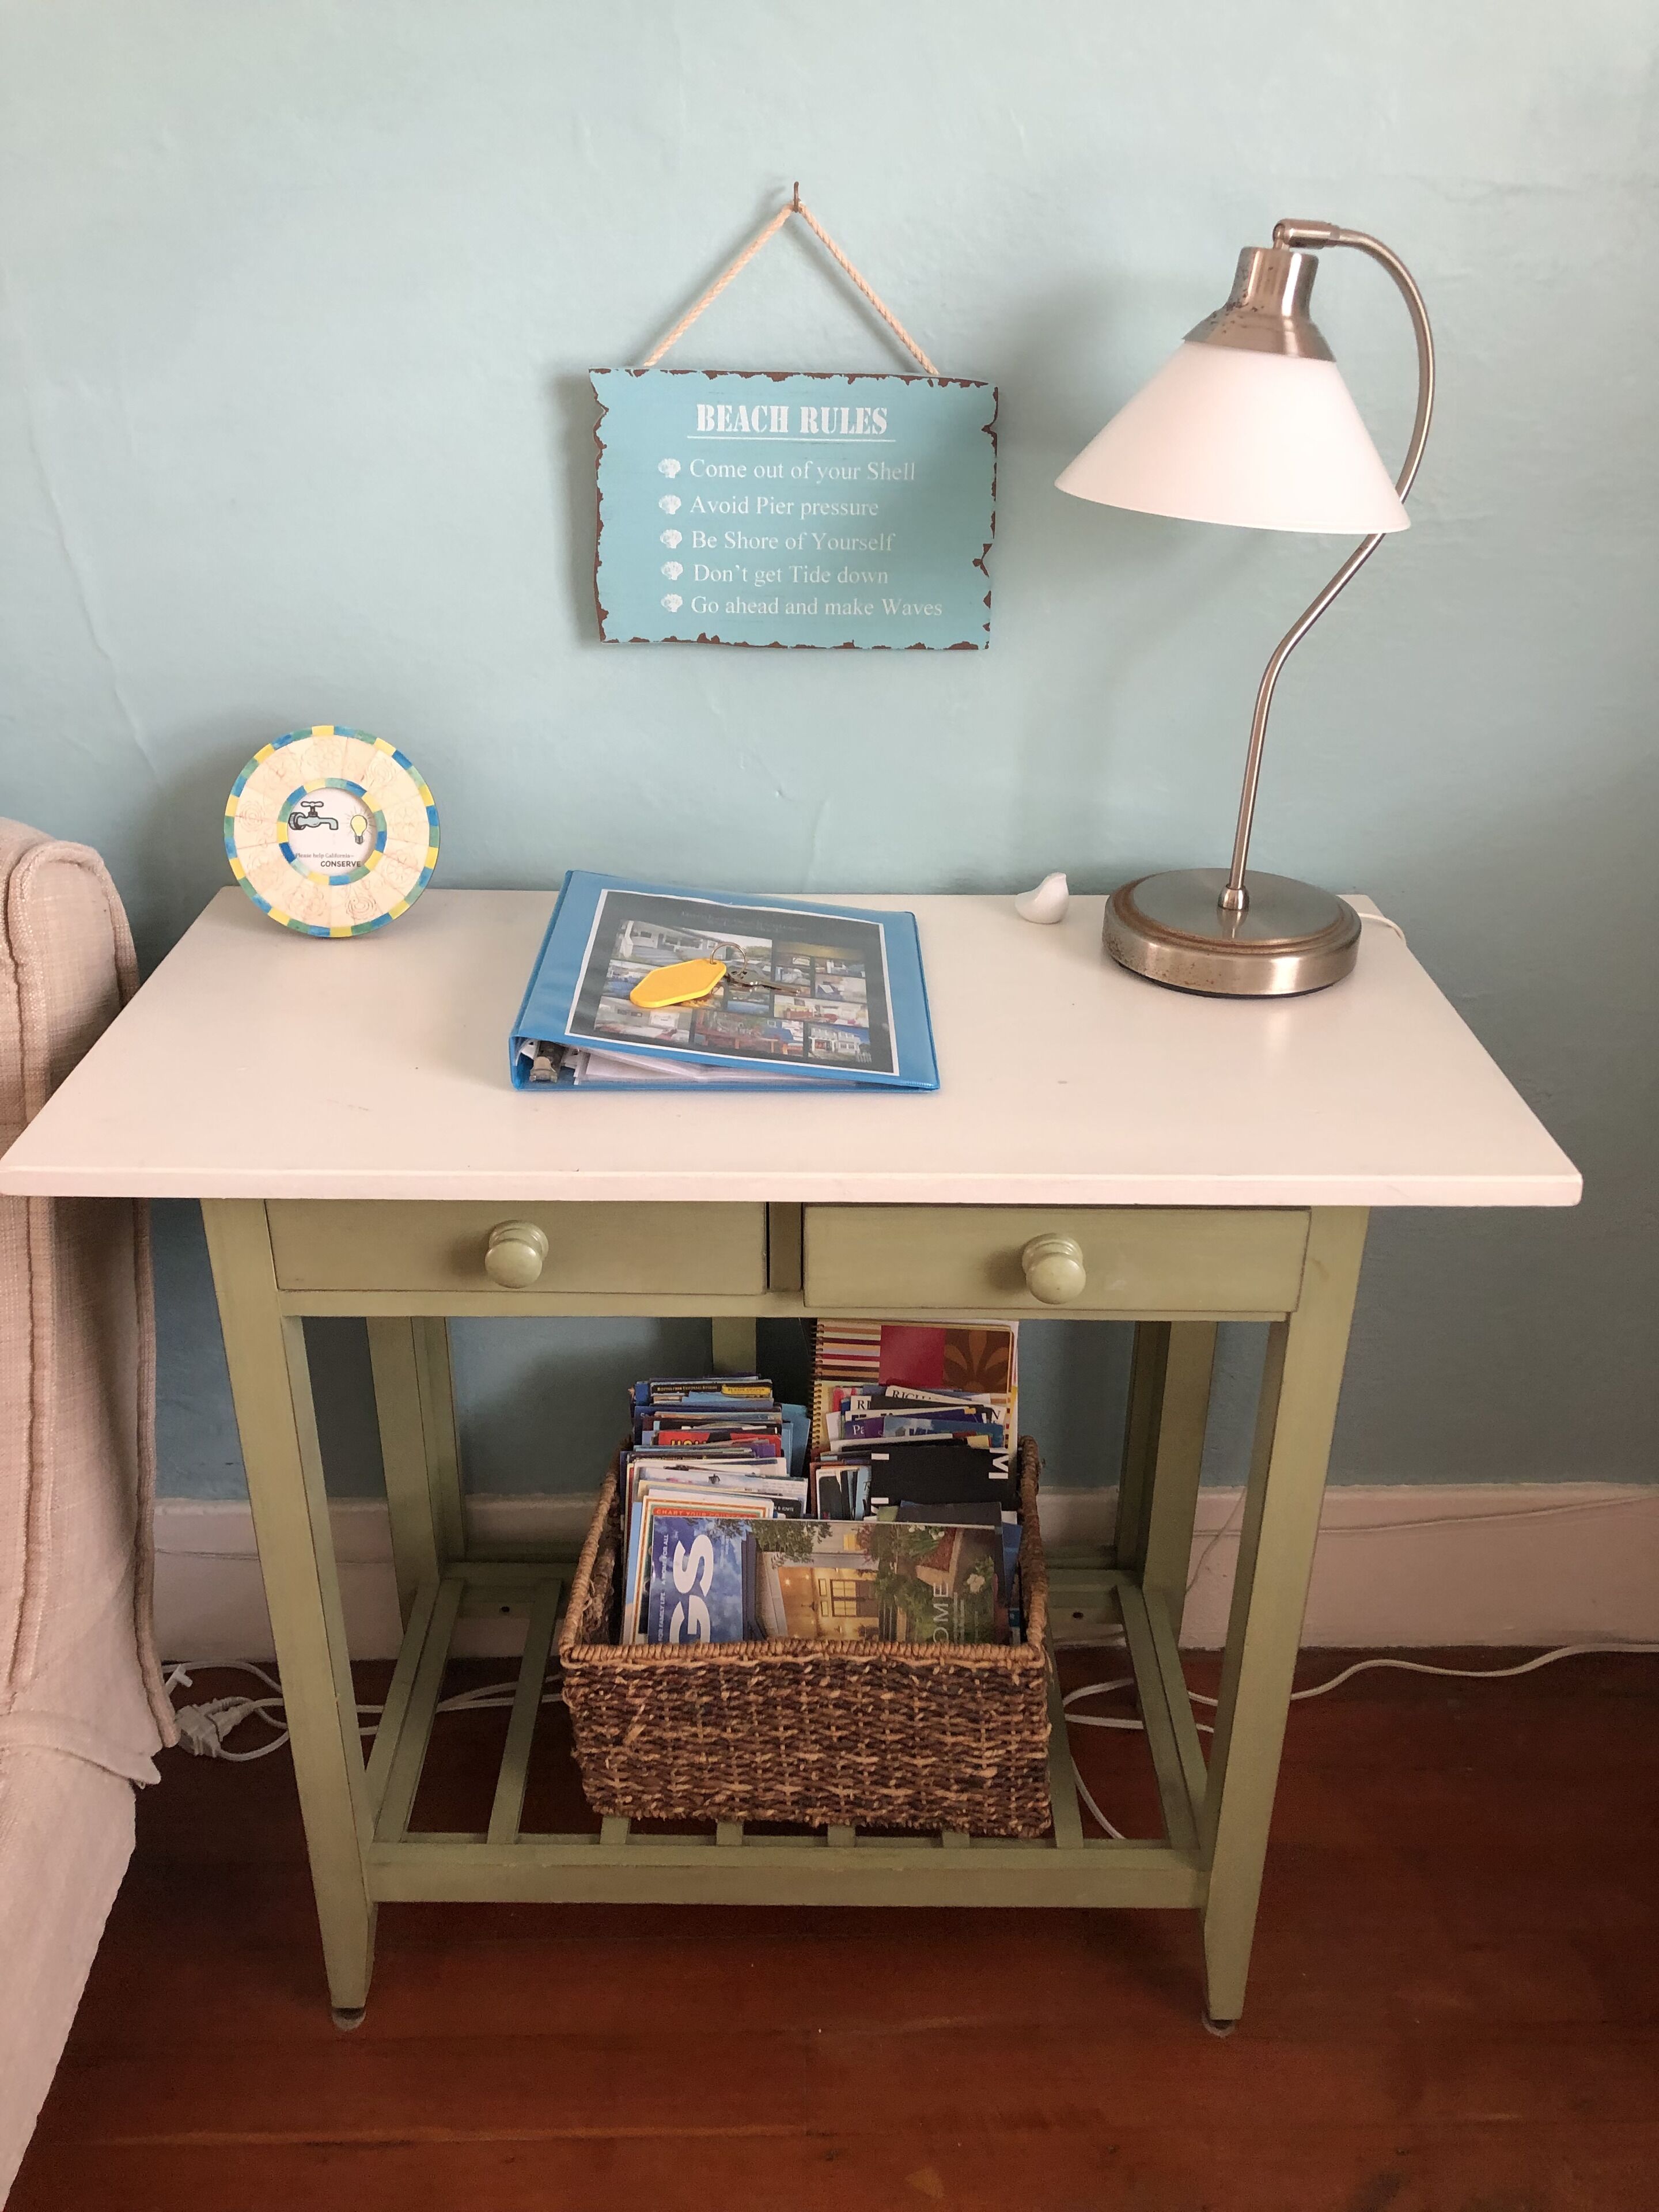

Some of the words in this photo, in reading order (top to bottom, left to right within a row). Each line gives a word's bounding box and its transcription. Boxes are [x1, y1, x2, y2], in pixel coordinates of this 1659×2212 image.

[696, 403, 790, 433] BEACH
[800, 406, 888, 434] RULES
[690, 459, 747, 478] Come
[753, 463, 784, 479] out
[790, 460, 814, 479] of
[816, 465, 861, 484] your
[867, 461, 915, 481] Shell
[690, 495, 749, 514] Avoid
[756, 496, 794, 515] Pier
[800, 502, 879, 520] pressure
[691, 531, 717, 549] Be
[724, 531, 778, 550] Shore
[785, 532, 808, 550] of
[811, 532, 896, 551] Yourself
[694, 564, 748, 582] Don't
[754, 567, 783, 588] get
[789, 565, 831, 584] Tide
[837, 566, 889, 584] down
[691, 596, 719, 614] Go
[725, 596, 779, 615] ahead
[785, 597, 818, 615] and
[824, 597, 874, 615] make
[881, 598, 942, 616] Waves
